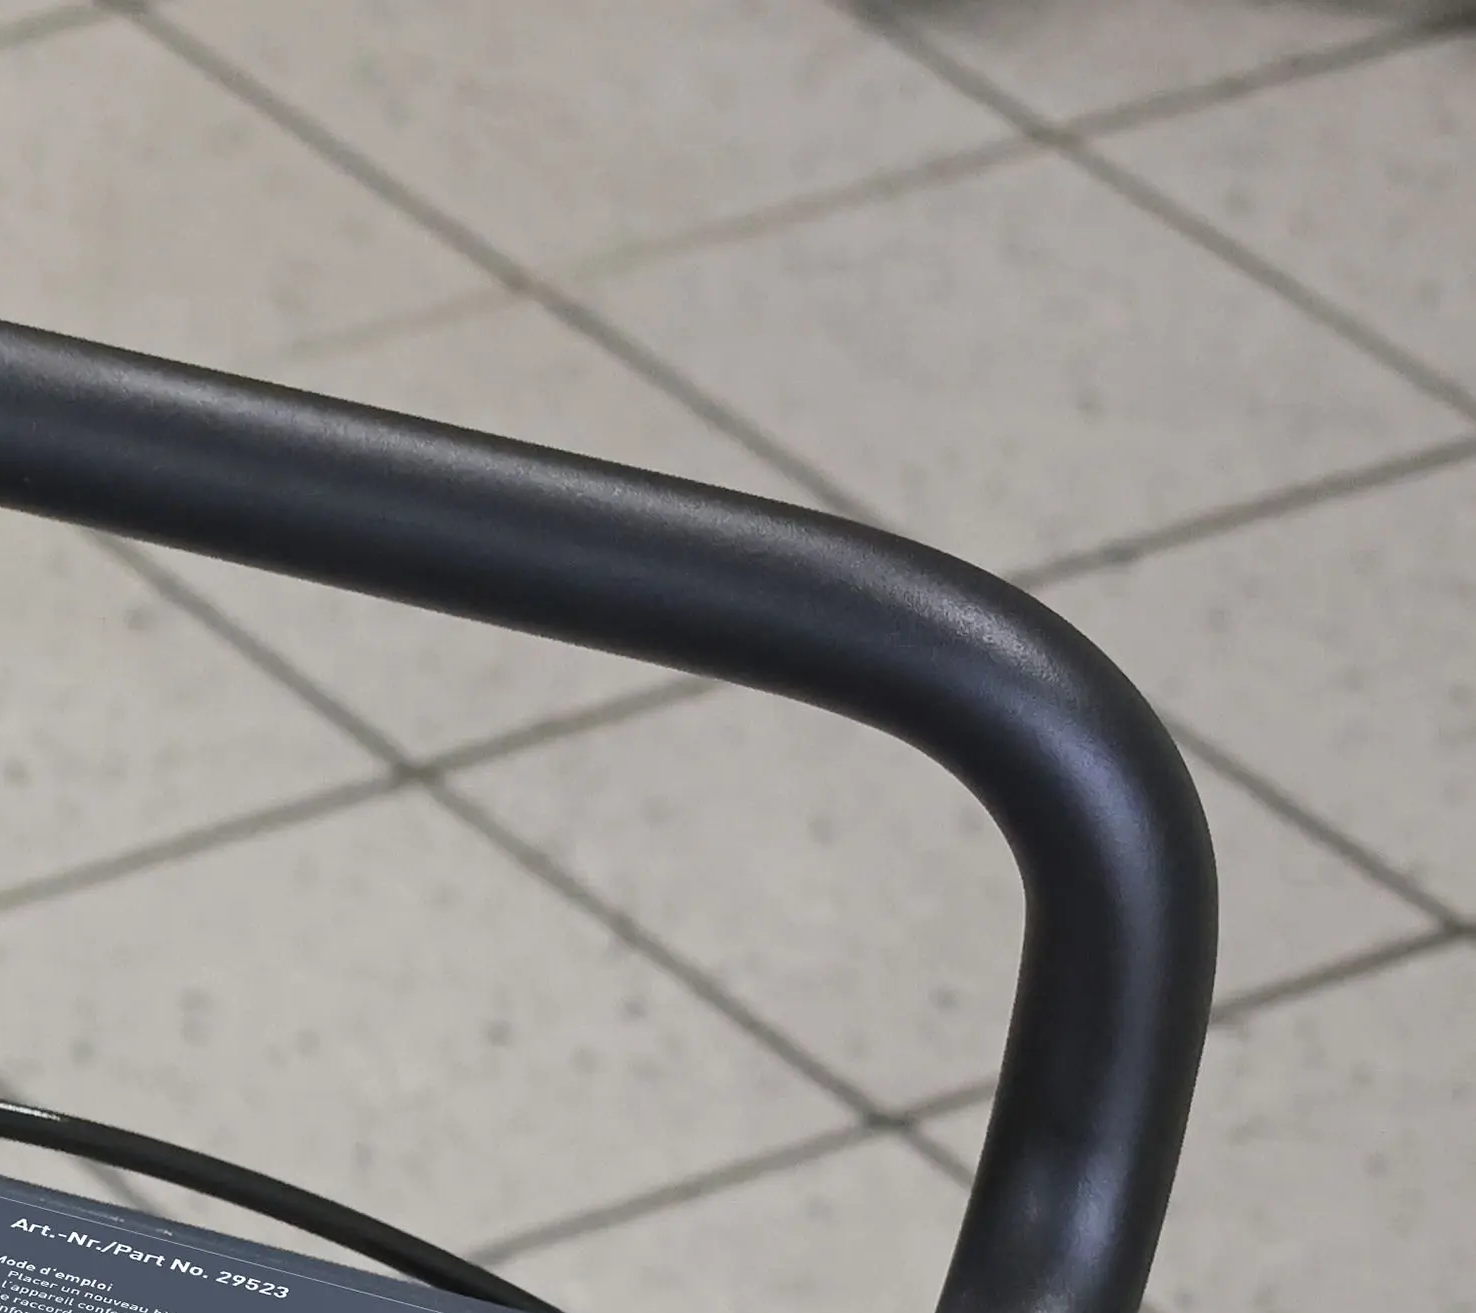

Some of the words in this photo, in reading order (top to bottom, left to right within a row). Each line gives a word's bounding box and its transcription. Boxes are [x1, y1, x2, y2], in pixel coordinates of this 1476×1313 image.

[11, 1219, 165, 1266] Art.-Nr./Part
[170, 1259, 208, 1278] No.
[216, 1271, 289, 1298] 29523
[7, 1270, 59, 1289] Placer
[60, 1285, 81, 1296] un
[83, 1291, 149, 1313] nouveau
